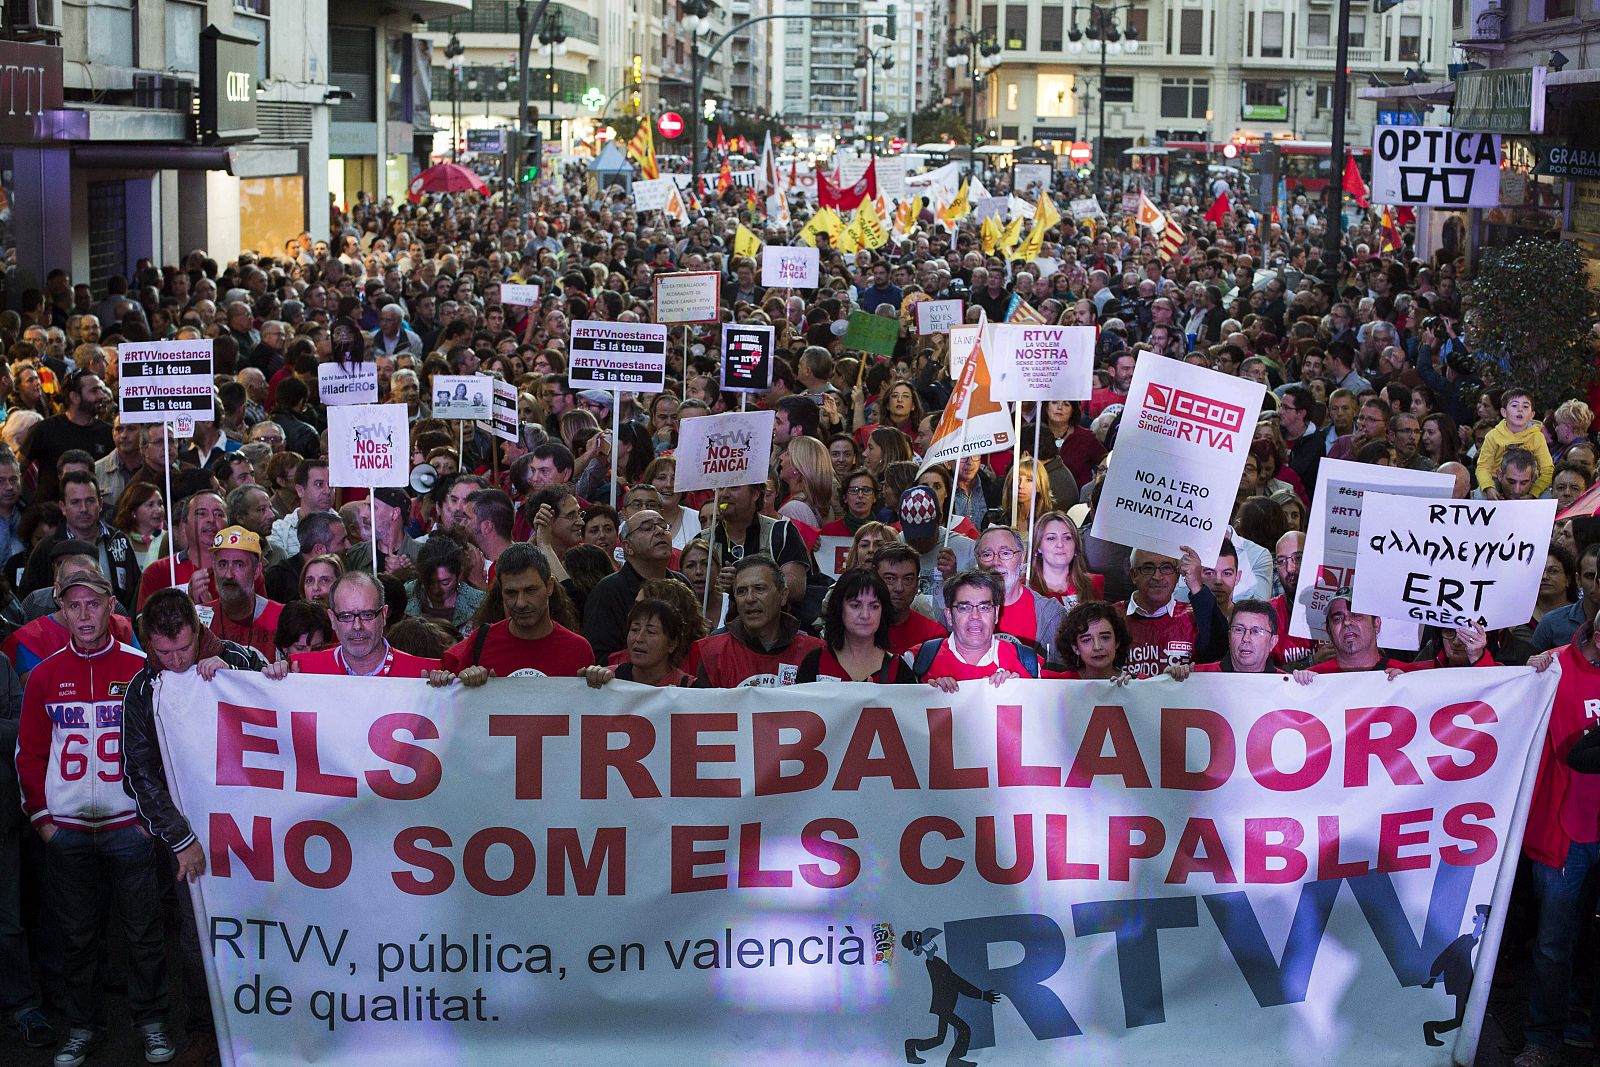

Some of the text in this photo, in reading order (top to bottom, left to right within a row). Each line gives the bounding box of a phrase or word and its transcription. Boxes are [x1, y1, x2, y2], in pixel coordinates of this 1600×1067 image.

[0, 65, 44, 116] TTI
[1378, 130, 1497, 165] OPTICA
[1550, 166, 1566, 174] POR
[576, 328, 664, 340] #RTVVnoestanca
[954, 336, 962, 344] LA
[1024, 331, 1063, 341] RTVV
[593, 340, 644, 352] És la teua
[1016, 349, 1068, 359] NOSTRA
[125, 350, 211, 361] #RTVVnoestanca
[142, 363, 191, 375] És la teua
[575, 358, 663, 370] #RTVVnoestanca
[592, 369, 643, 382] És la teua
[125, 385, 211, 396] #RTVVnoestanca
[321, 382, 375, 395] #lladrEROs
[143, 398, 192, 410] És la teua
[1175, 396, 1240, 427] CCOO
[1140, 410, 1178, 427] Sección
[1137, 420, 1234, 453] Sindical RTVA
[353, 455, 393, 469] TANCA!
[703, 458, 748, 474] TANCA!
[1135, 470, 1210, 498] NO A L'ERO
[1142, 488, 1194, 511] NO A LA
[1115, 497, 1213, 531] PRIVATITZACIÓ
[1402, 572, 1497, 612] ERT
[215, 700, 1498, 800] ELS TREBALLADORS
[209, 802, 1498, 897] NO SOM ELS CULPABLES
[209, 917, 866, 982] RTVV, pública, en valencià
[944, 850, 1476, 1050] RTVV
[234, 975, 499, 1030] de qualitat.
